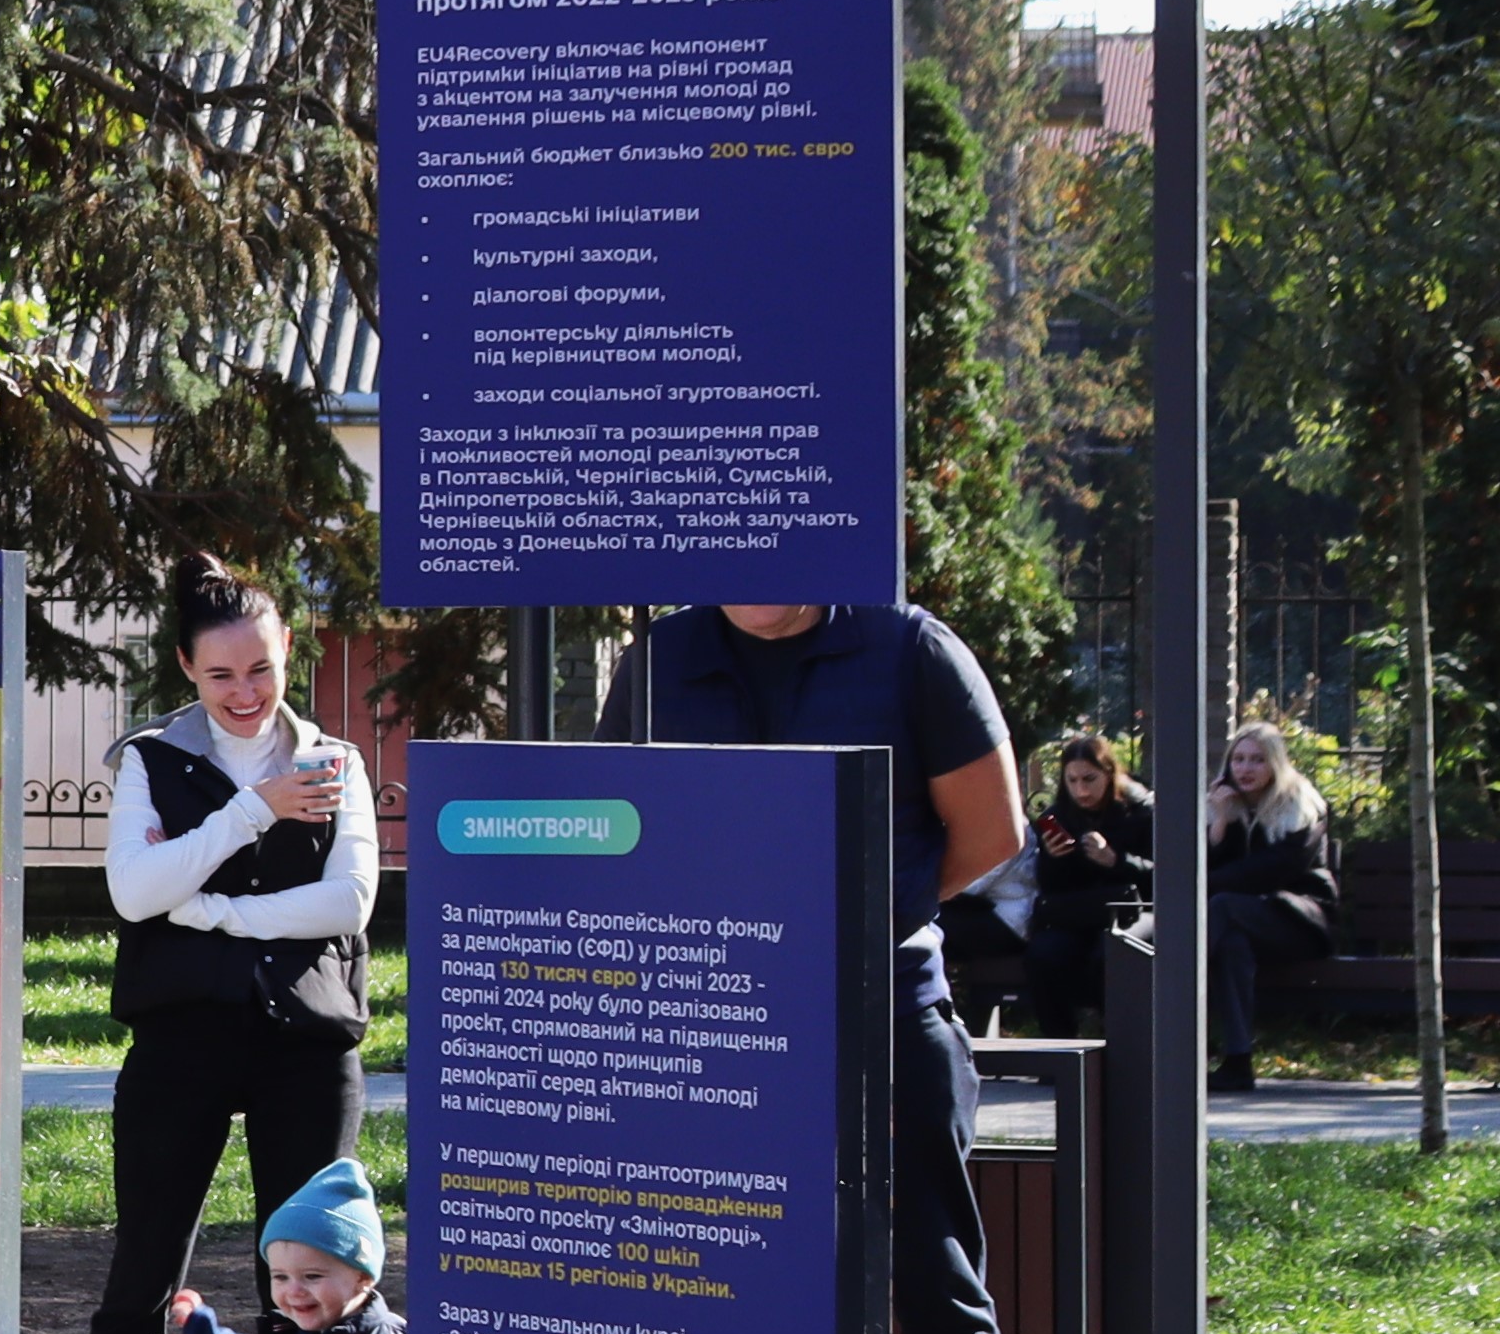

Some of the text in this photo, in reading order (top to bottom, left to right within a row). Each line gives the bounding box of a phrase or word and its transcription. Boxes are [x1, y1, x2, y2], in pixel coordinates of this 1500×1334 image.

[417, 38, 768, 64] EU4Recovery включає компонент
[417, 142, 854, 167] Загальний бюджет близько 200 тис. євро
[473, 205, 700, 230] громадські ініціативи
[419, 423, 820, 445] Заходи з інклюзії та розширення прав
[463, 816, 610, 842] ЗМІНОТВОРЦІ
[441, 903, 784, 944] За підтримки Європейського фонду
[441, 959, 496, 981] понад
[500, 960, 530, 980] 130
[533, 965, 587, 983] тисяч
[591, 969, 637, 990] євро
[640, 971, 654, 992] у
[657, 968, 703, 991] січні
[707, 971, 752, 994] 2023
[439, 1141, 788, 1194] У першому періоді грантоотримувач
[439, 1252, 735, 1299] у громадах 15 регіонів України.
